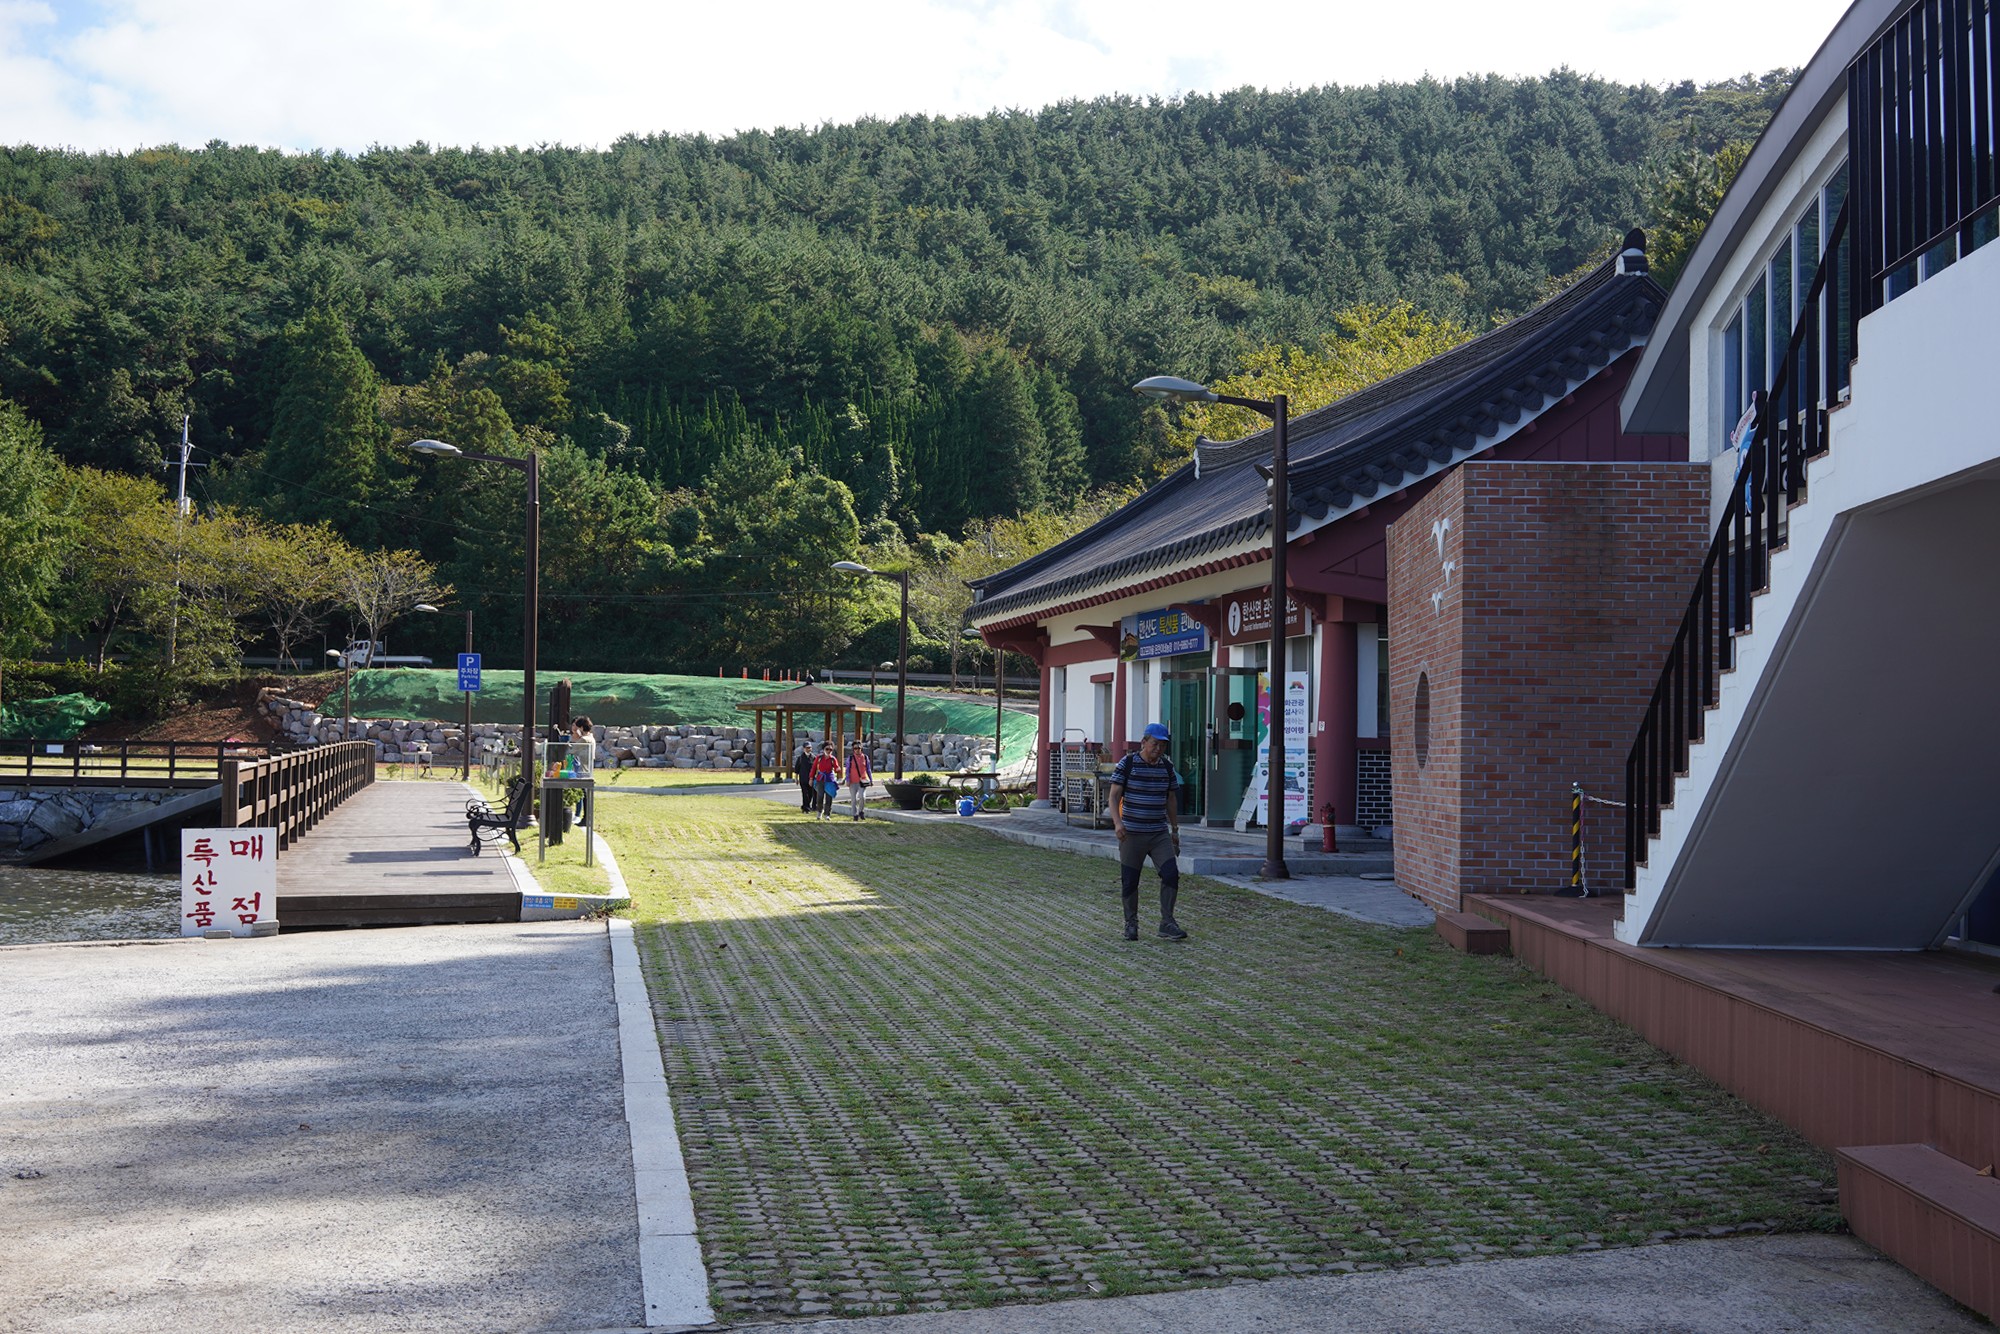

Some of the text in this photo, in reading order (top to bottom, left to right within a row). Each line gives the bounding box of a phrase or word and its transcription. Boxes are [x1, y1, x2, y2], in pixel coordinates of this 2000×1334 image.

[1242, 598, 1262, 622] 한산면
[1138, 618, 1158, 640] 한산도
[1159, 613, 1179, 636] 특산품
[1253, 621, 1269, 631] Information
[466, 656, 475, 667] P
[460, 667, 479, 675] 주차장
[1284, 699, 1305, 707] 화관광
[1284, 708, 1305, 716] 설사와
[1284, 726, 1305, 735] 영여행
[186, 837, 220, 929] 특산품
[229, 834, 264, 928] 매점
